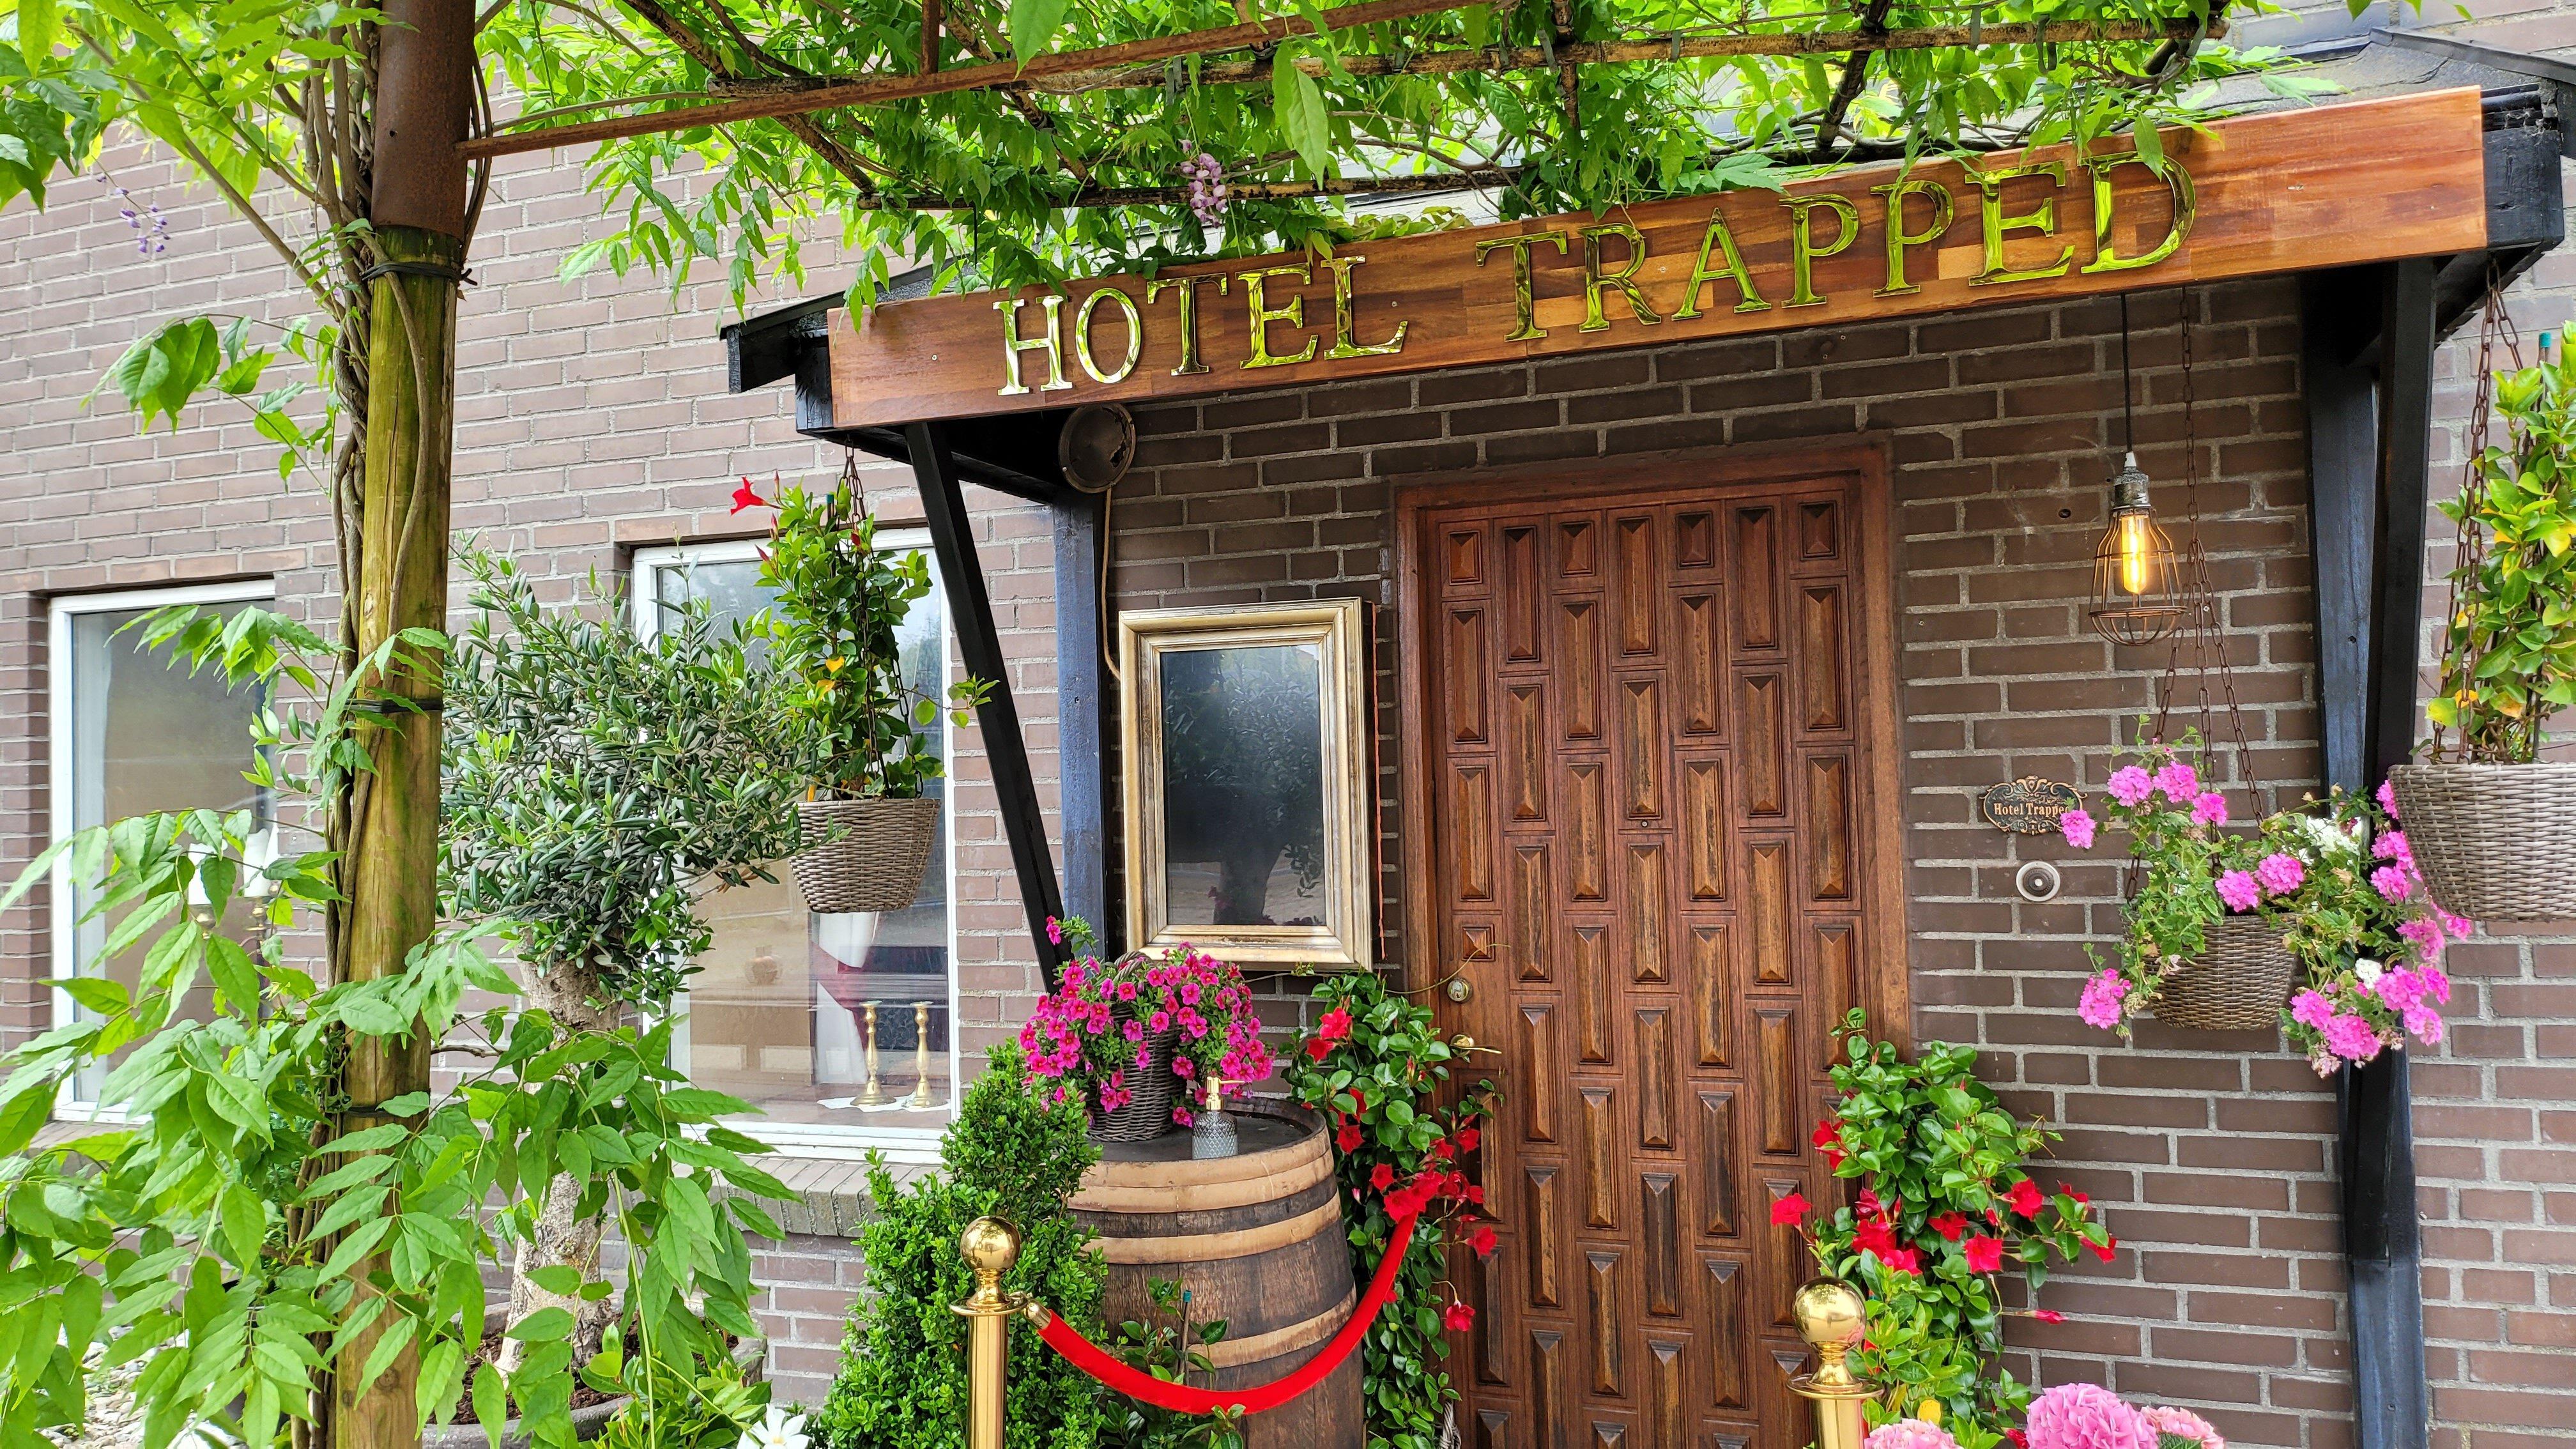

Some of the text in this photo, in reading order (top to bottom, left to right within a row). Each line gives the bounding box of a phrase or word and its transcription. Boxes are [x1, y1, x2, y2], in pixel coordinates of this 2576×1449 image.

[992, 151, 2196, 396] HOTEL TRAPPED
[1993, 802, 2024, 815] Hotel
